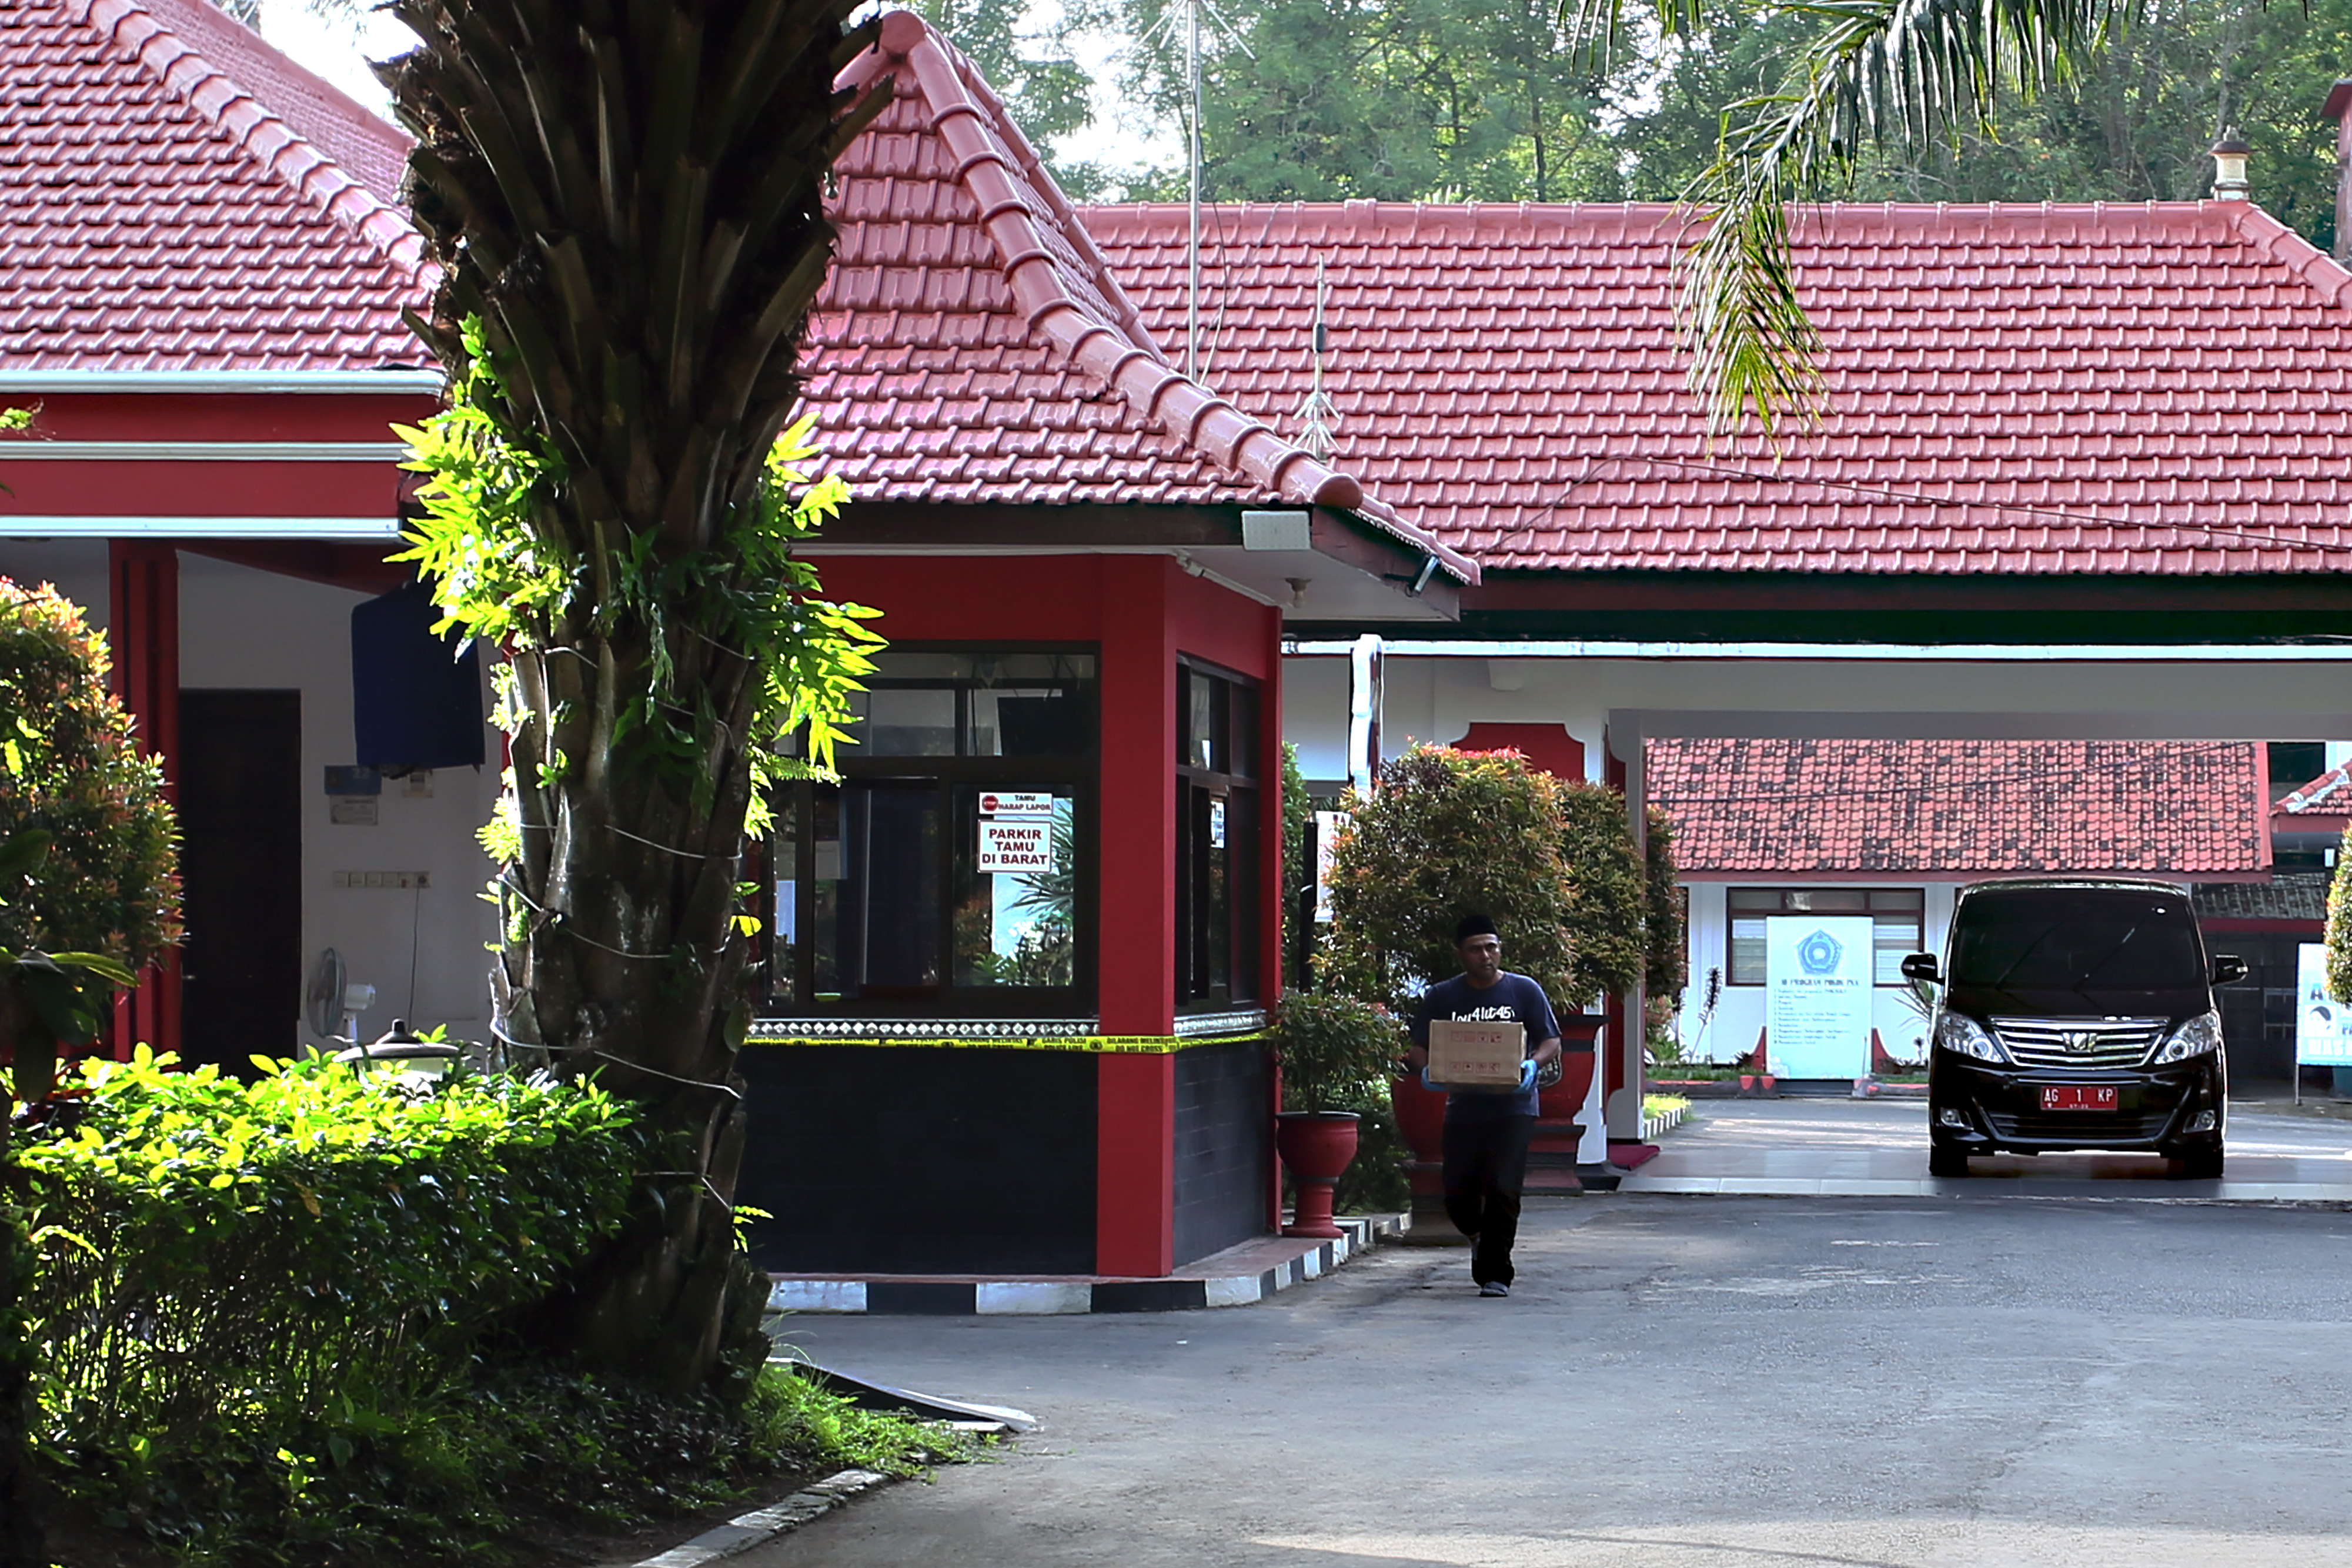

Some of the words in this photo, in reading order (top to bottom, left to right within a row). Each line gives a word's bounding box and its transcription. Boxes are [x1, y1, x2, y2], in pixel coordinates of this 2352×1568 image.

[989, 829, 1041, 840] PARKIR
[995, 841, 1035, 852] TAMU
[982, 854, 996, 864] DI
[1001, 854, 1048, 865] BARAT
[2044, 1089, 2059, 1102] AG
[2077, 1089, 2082, 1102] 1
[2097, 1089, 2113, 1102] KP
